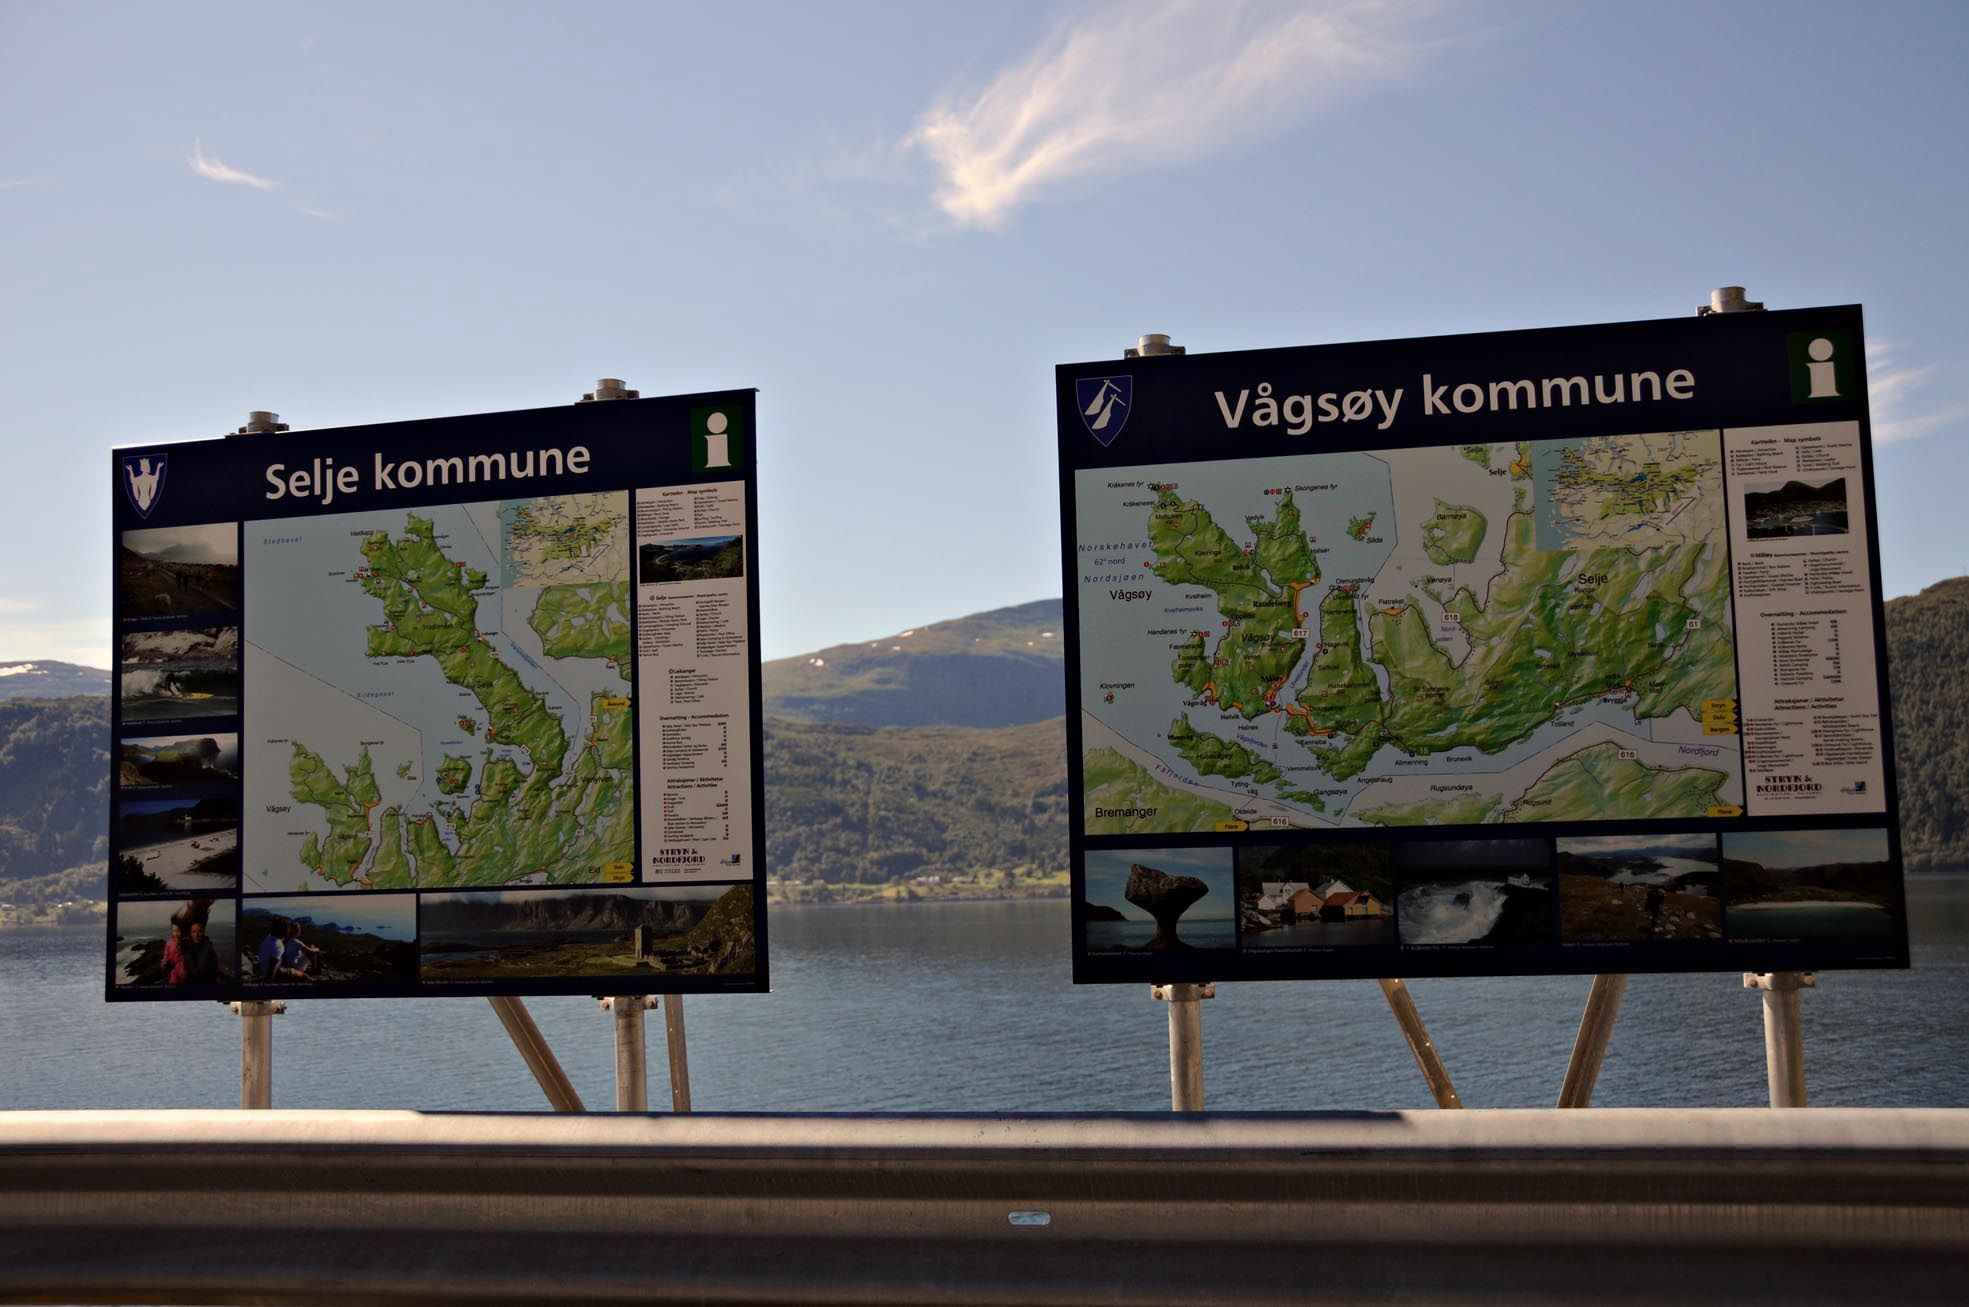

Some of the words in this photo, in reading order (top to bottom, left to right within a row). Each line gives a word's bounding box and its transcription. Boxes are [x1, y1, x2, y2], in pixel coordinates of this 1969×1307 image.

[1214, 382, 1404, 436] Vågsøy
[1422, 369, 1695, 415] kommune
[266, 457, 359, 505] Selje
[373, 446, 590, 491] kommune
[1489, 468, 1507, 477] Selje
[1437, 511, 1467, 520] Barmøya
[1079, 542, 1152, 552] Norskehavet
[1084, 573, 1144, 583] Nordsjøen
[1578, 573, 1608, 584] Selje
[1109, 590, 1152, 602] Vågsøy
[1241, 634, 1276, 643] Vågsøy
[1100, 682, 1135, 690] Klovningen
[1678, 746, 1719, 757] Nordfjord
[1430, 784, 1473, 792] Rugsundøya
[1756, 784, 1822, 793] NORDFJORD
[266, 805, 291, 814] Vågsøy
[1095, 807, 1157, 818] Bremanger
[653, 855, 705, 864] NORDFJORD
